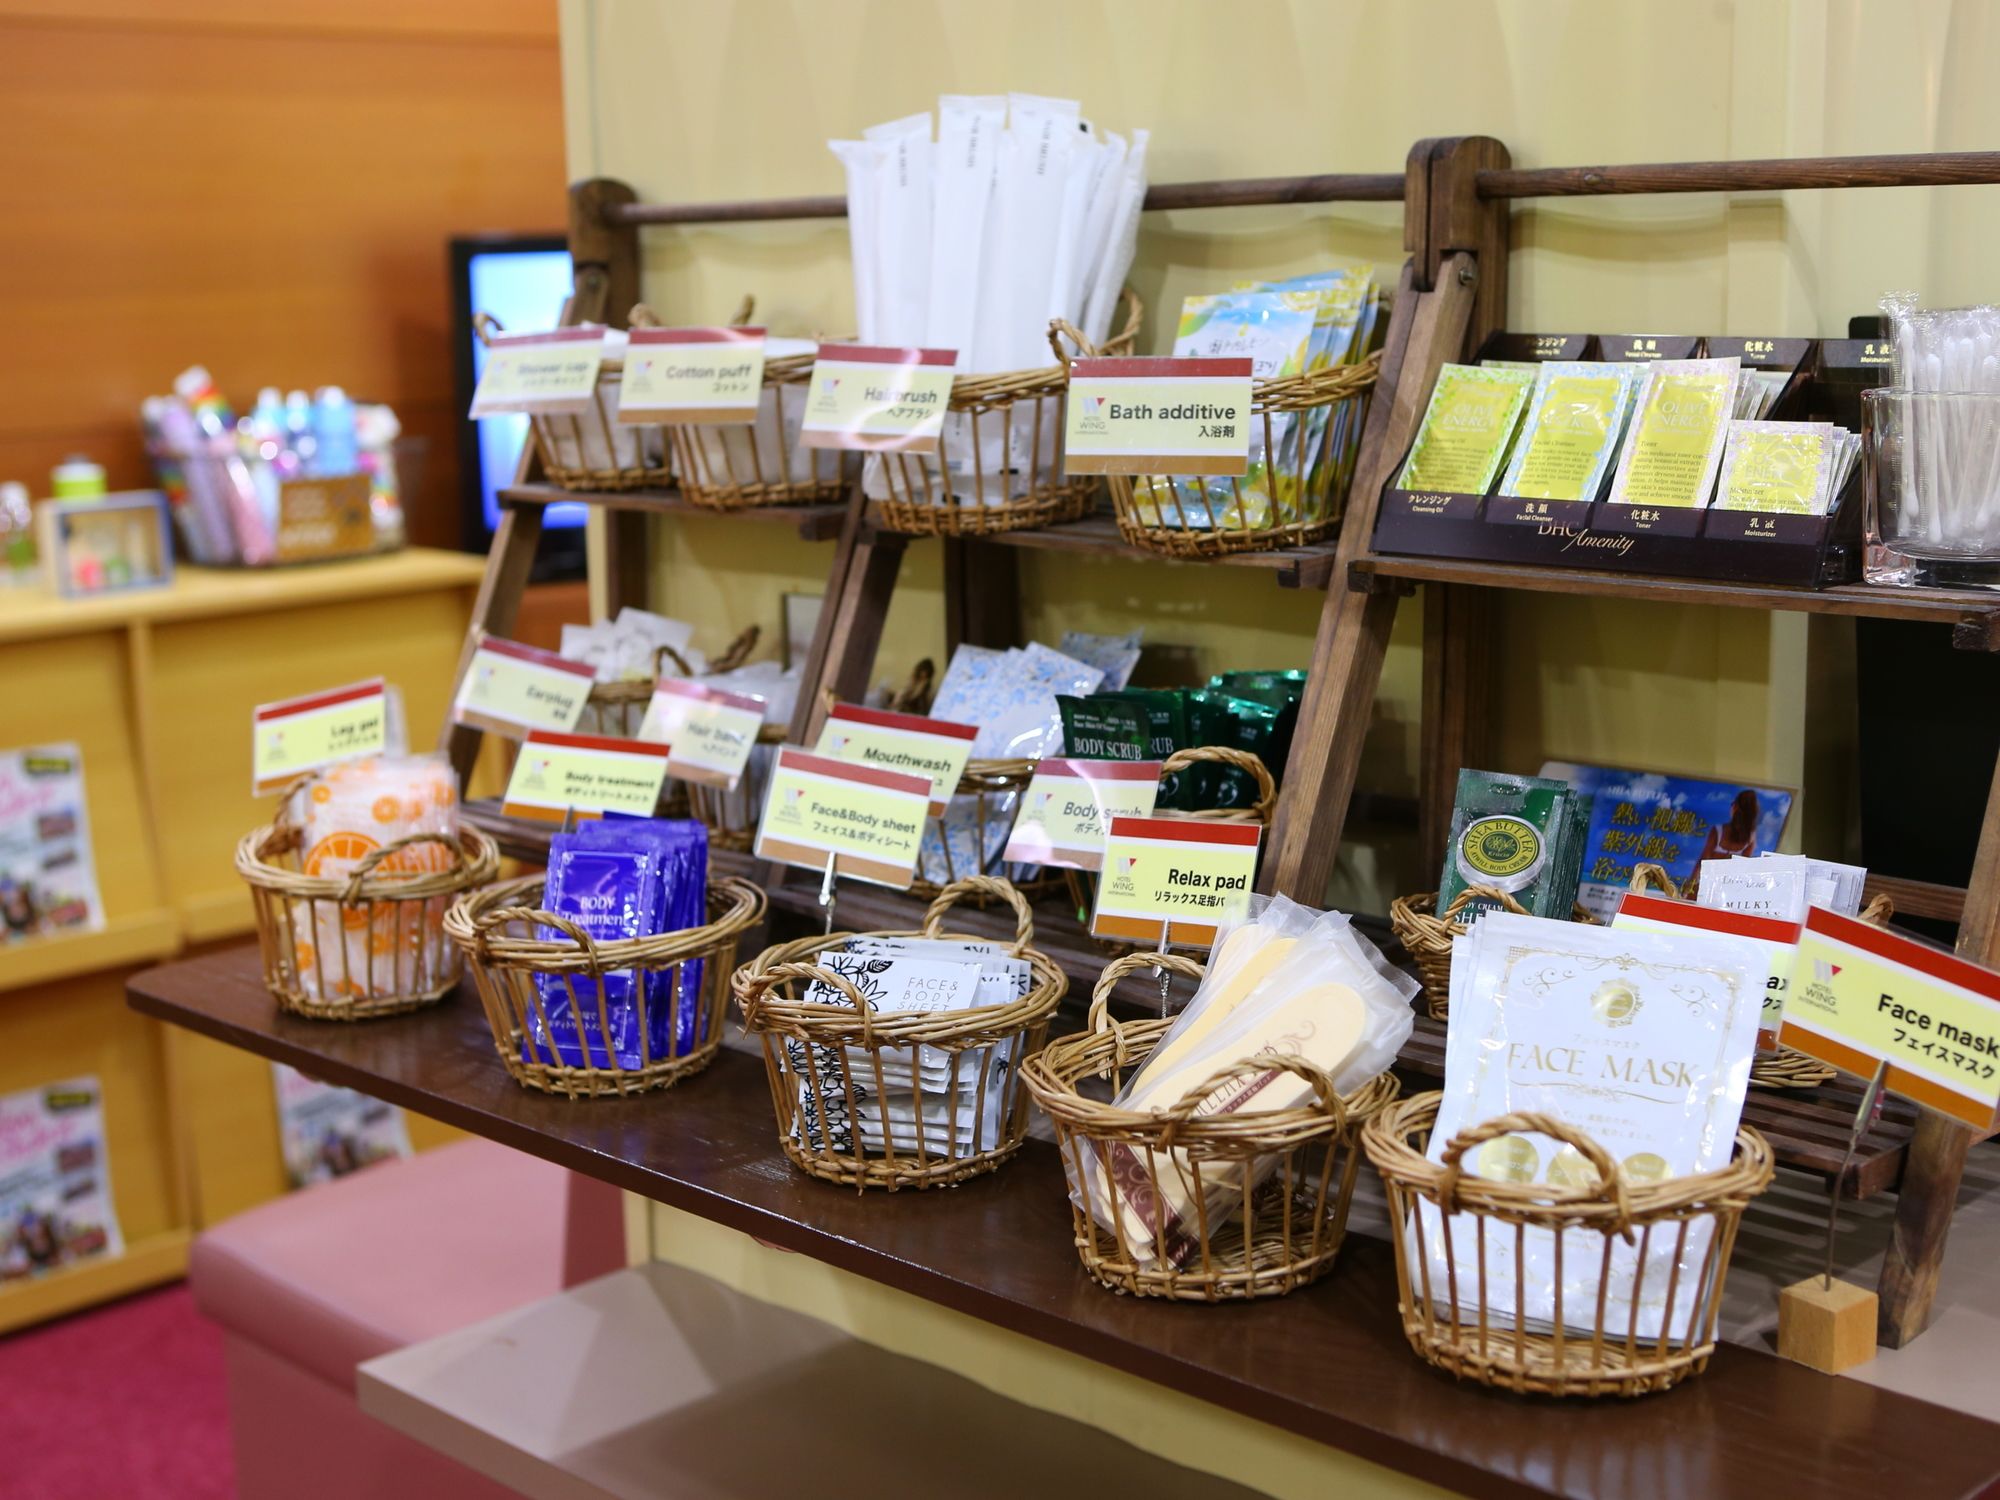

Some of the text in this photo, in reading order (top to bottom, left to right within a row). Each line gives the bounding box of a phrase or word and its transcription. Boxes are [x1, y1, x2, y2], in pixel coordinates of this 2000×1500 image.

[666, 363, 753, 380] Cotton puff
[1110, 404, 1236, 420] Bath additive
[1079, 422, 1106, 430] WING
[1198, 425, 1235, 438] 入浴剤
[1408, 494, 1452, 505] クレンジング
[1412, 505, 1435, 514] Cleansing
[1525, 503, 1548, 514] 洗顔
[1631, 509, 1660, 521] 化粧水
[1538, 520, 1580, 536] DHC
[1744, 529, 1777, 537] Moisturizer
[1561, 528, 1635, 556] Amenity
[1074, 737, 1142, 760] BODY SCRUB
[863, 748, 952, 772] Mouthwash
[566, 772, 655, 788] Body treatment
[811, 802, 880, 828] Face&Body
[882, 819, 916, 834] sheet
[1063, 802, 1099, 820] Body
[1611, 802, 1707, 837] 熱い視線と
[1468, 822, 1534, 853] SHEA BUTTER
[1603, 830, 1680, 863] 紫外線を
[1112, 882, 1135, 891] WING
[1168, 868, 1247, 892] Relax pad
[580, 896, 616, 910] BODY
[1477, 903, 1504, 911] CREAM
[1726, 901, 1772, 909] MILKY
[1811, 982, 1833, 993] HOTEL
[902, 990, 956, 1003] BODY
[1805, 987, 1837, 1007] WING
[1877, 993, 2000, 1060] Face mask
[1892, 1028, 1996, 1080] フェイスマスク
[1507, 1042, 1699, 1088] FACE MASK
